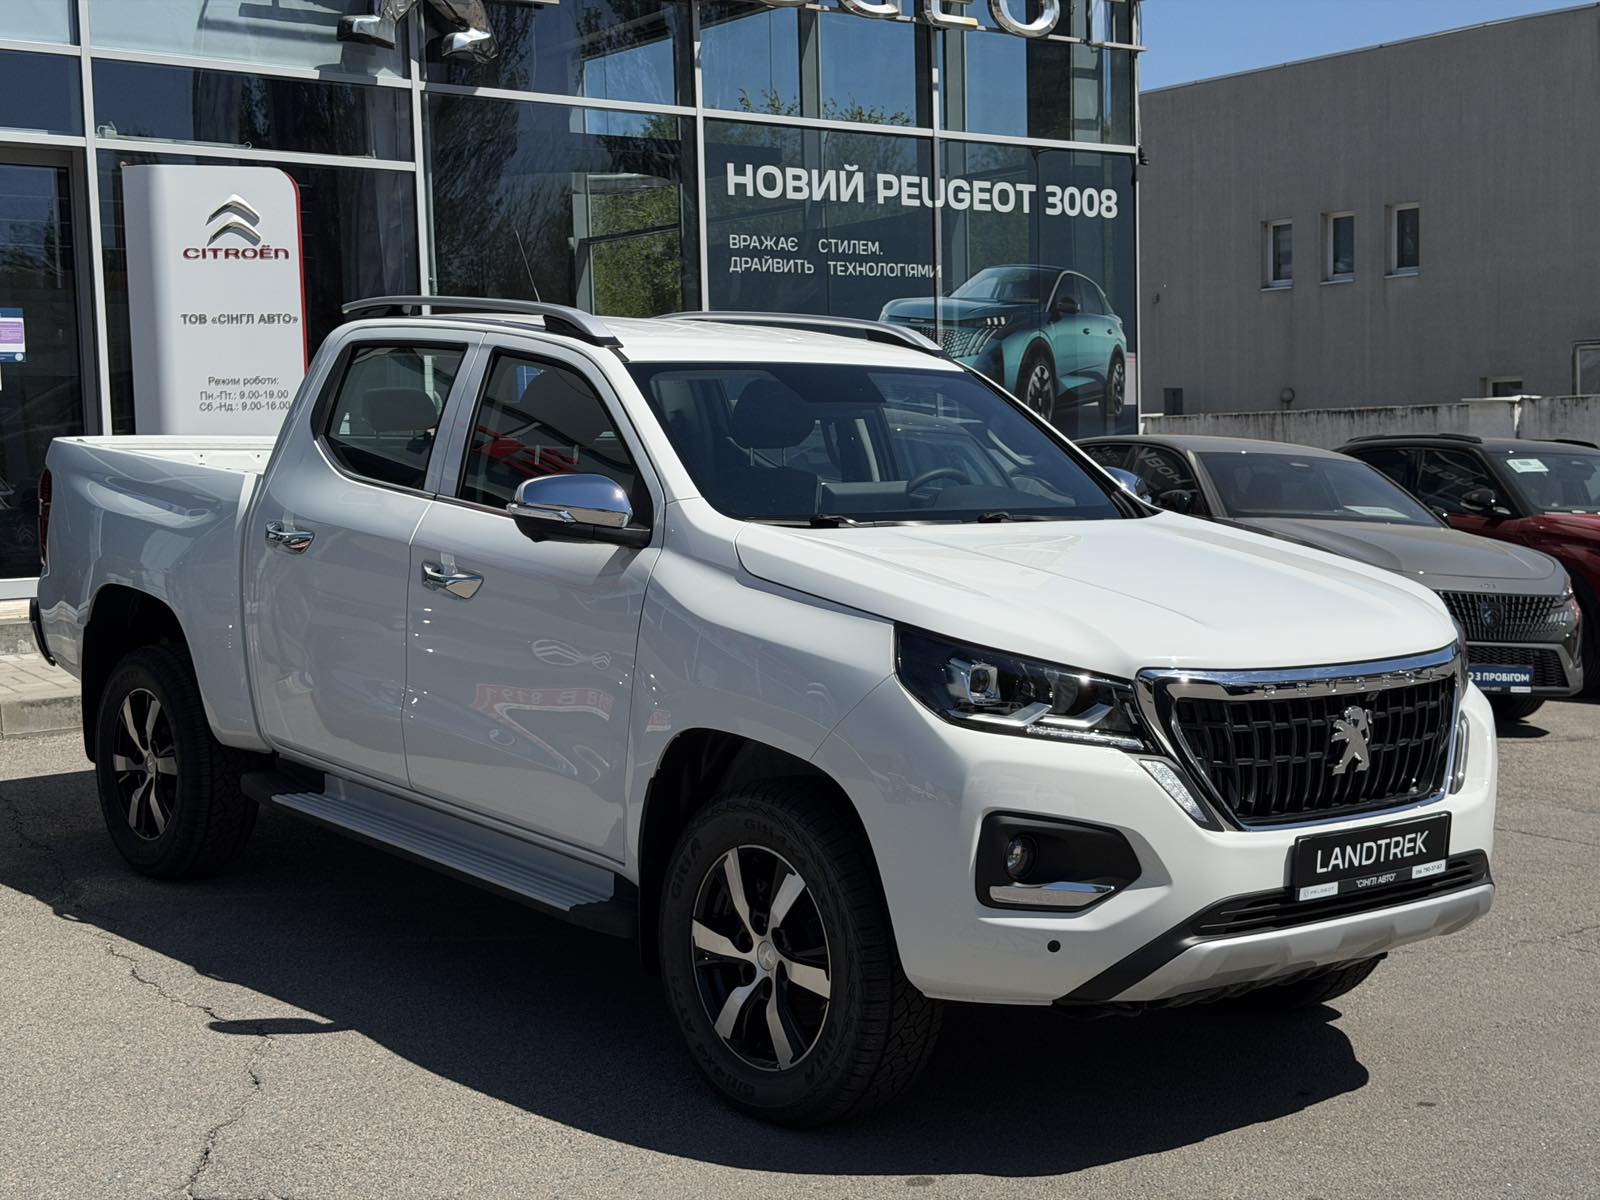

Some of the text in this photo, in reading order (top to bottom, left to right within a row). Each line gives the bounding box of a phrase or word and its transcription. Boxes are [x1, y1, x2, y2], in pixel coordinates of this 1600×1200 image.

[726, 162, 1119, 220] НОВИЙ PEUGEOT 3008
[729, 234, 884, 256] ВРАЖАЄ СТИЛЕМ.
[729, 255, 815, 275] ДРАЙВИТЬ
[181, 313, 299, 325] ТОВ «СІНГЛ АВТО»
[208, 376, 279, 387] Режим роботи:
[239, 390, 289, 400] 9.00-19.00
[1483, 672, 1530, 682] ПРОБІГОМ
[1316, 830, 1429, 874] LANDTREK
